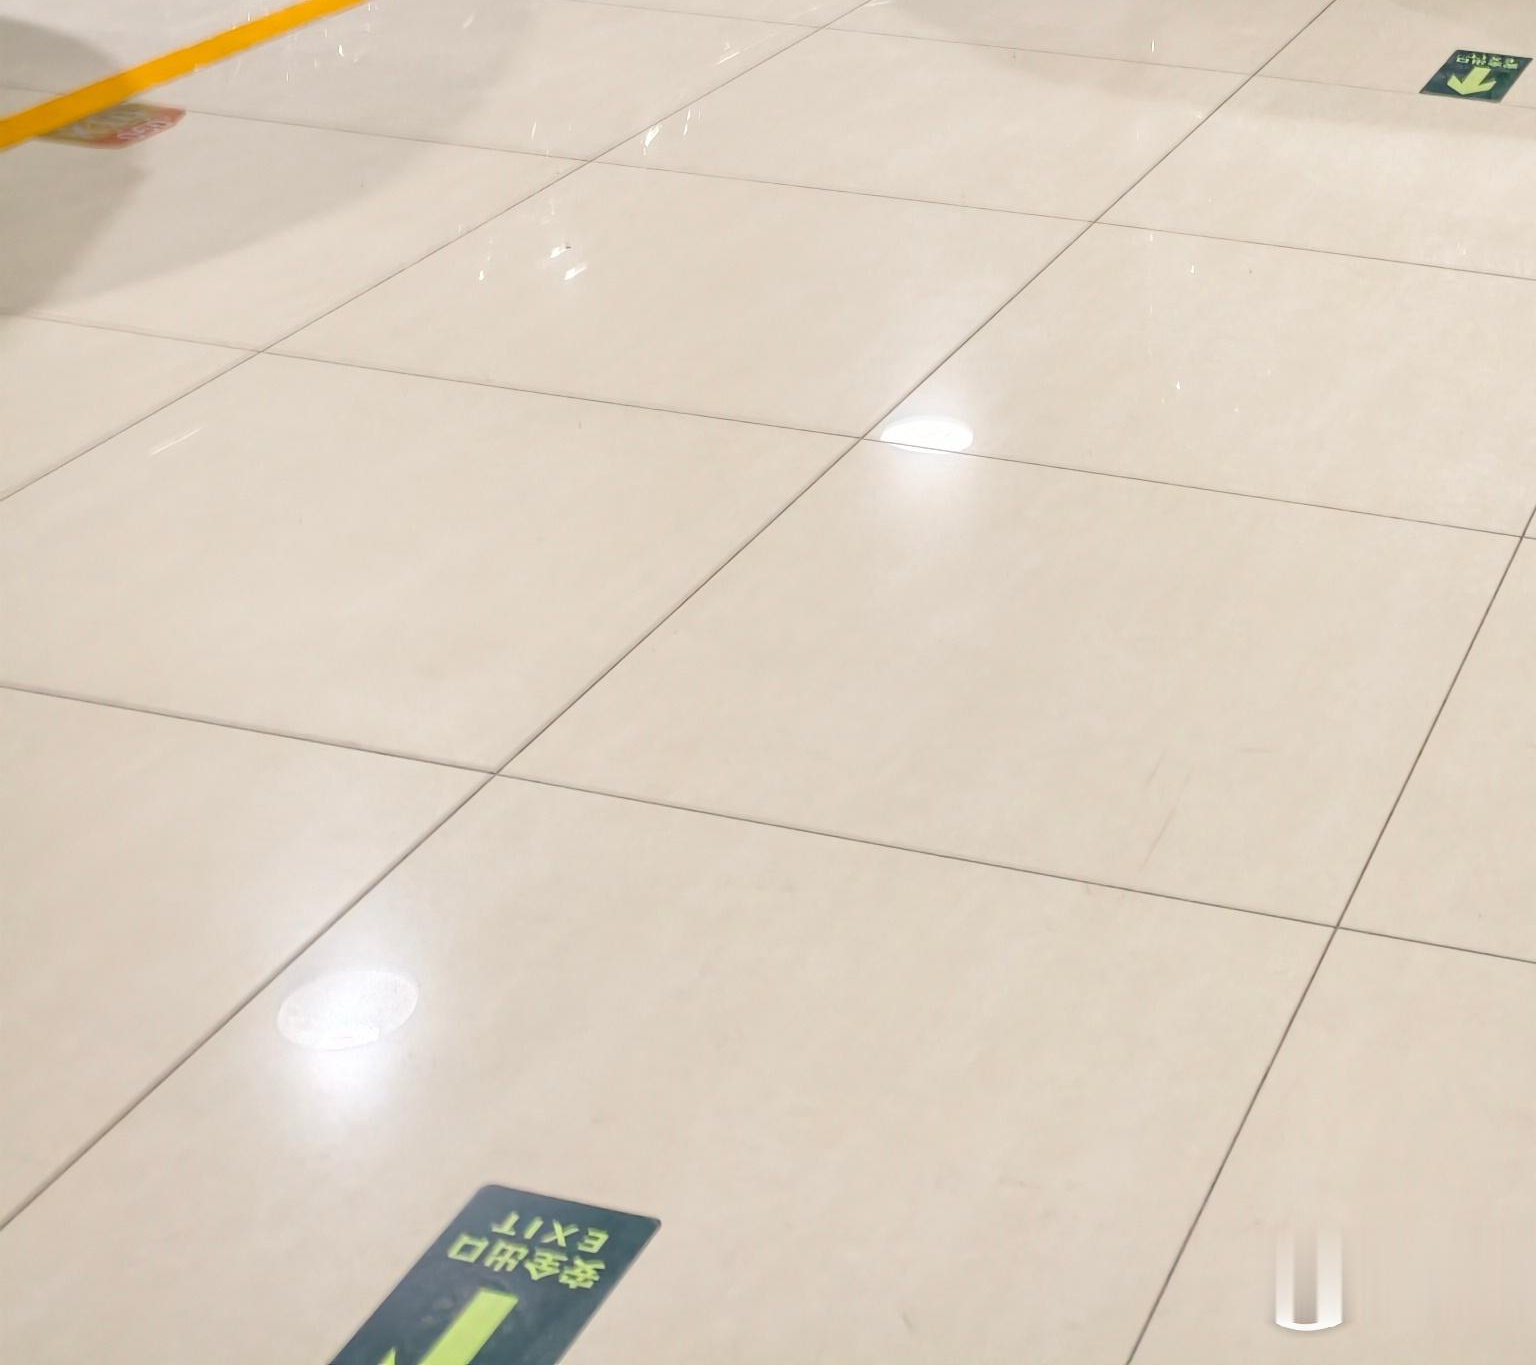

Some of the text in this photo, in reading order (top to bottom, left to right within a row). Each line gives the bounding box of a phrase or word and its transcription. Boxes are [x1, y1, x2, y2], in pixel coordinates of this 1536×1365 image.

[491, 1211, 609, 1254] EXIT
[447, 1232, 605, 1289] 安全出口
